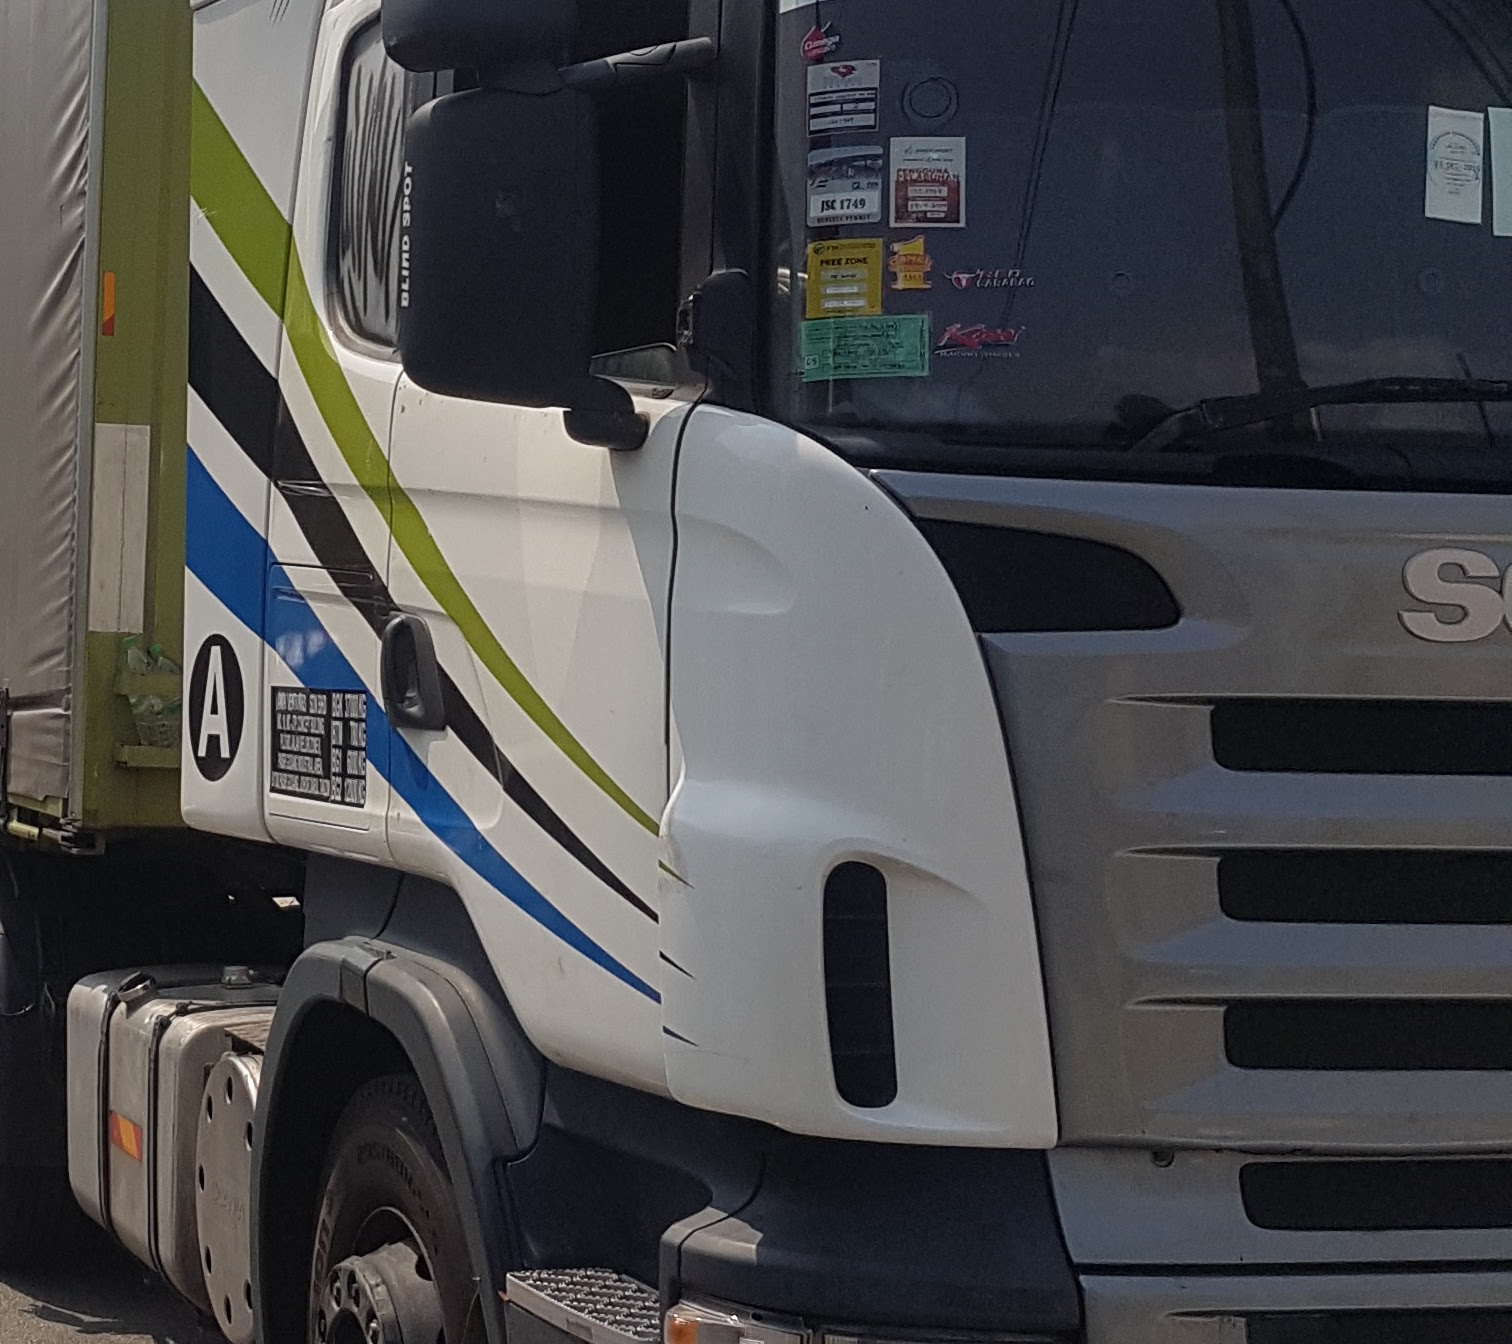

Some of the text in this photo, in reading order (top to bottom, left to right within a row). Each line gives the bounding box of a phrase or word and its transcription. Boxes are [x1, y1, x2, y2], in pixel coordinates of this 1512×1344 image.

[839, 197, 866, 210] 1749
[1397, 545, 1512, 643] S
[198, 645, 230, 758] A
